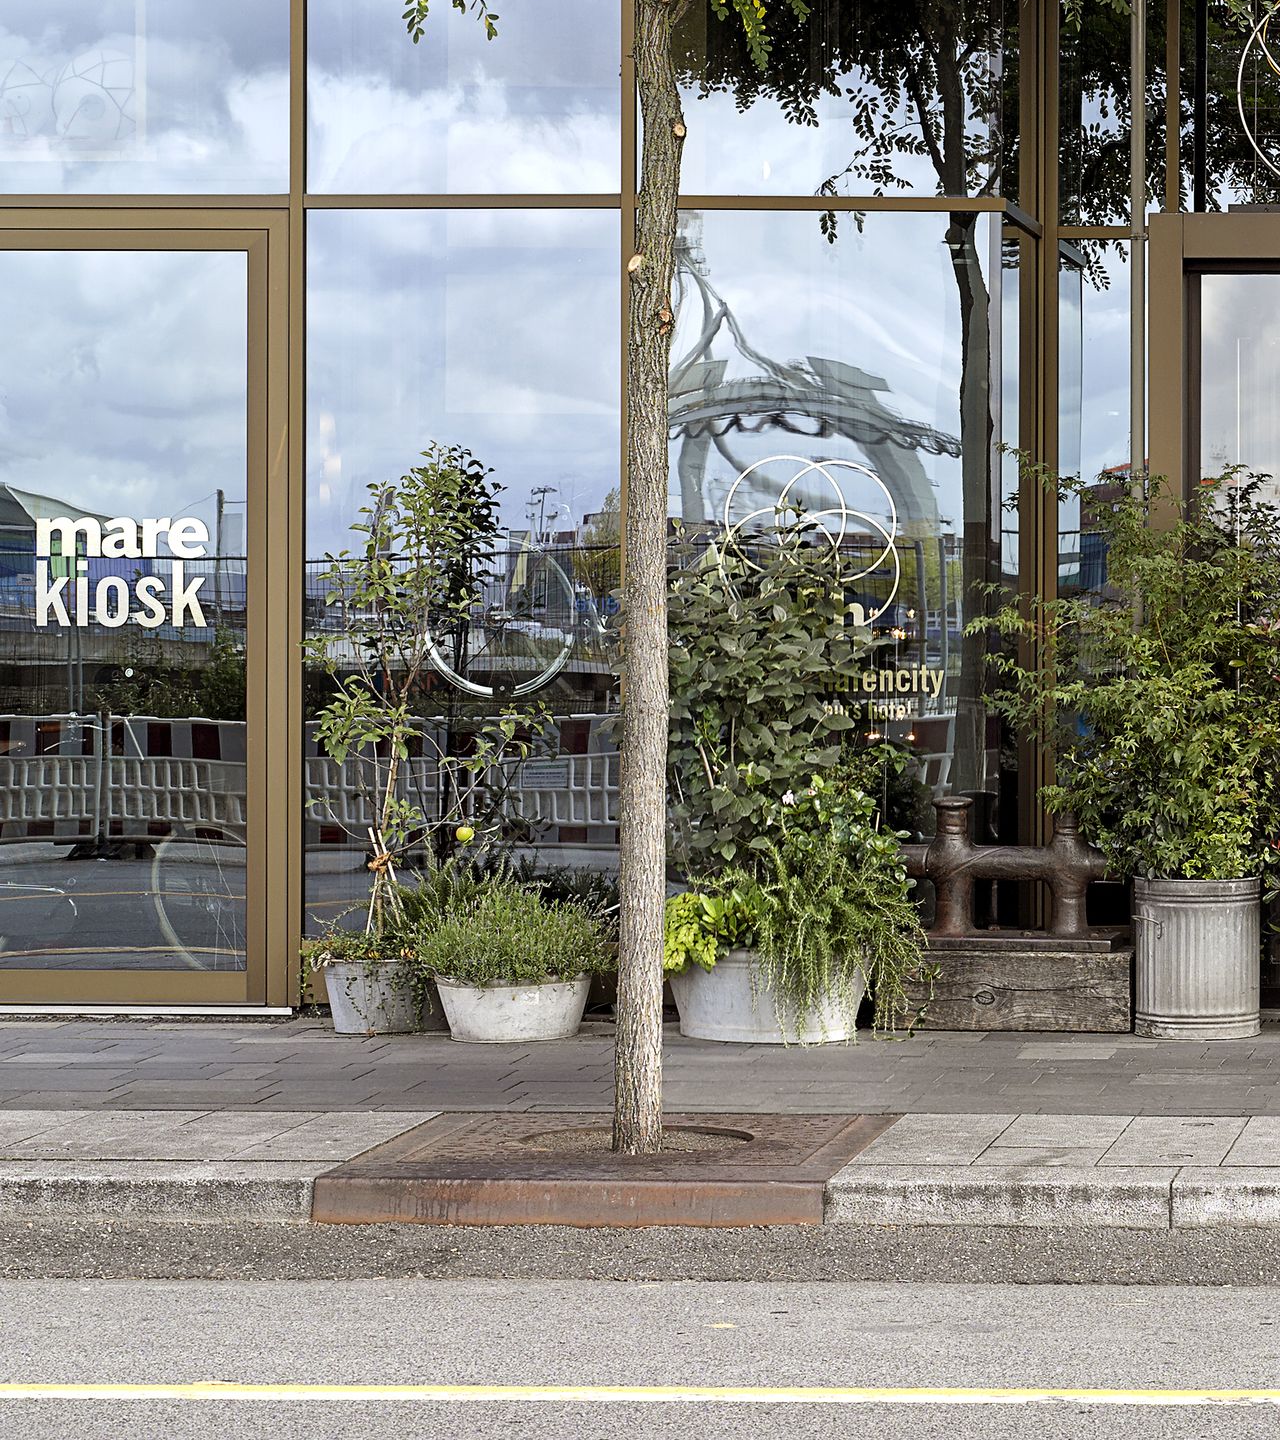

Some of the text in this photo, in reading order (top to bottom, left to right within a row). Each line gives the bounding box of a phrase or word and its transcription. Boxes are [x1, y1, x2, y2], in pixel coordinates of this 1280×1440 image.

[36, 517, 209, 558] mare
[36, 560, 207, 628] kiosk
[868, 698, 912, 721] hotel
